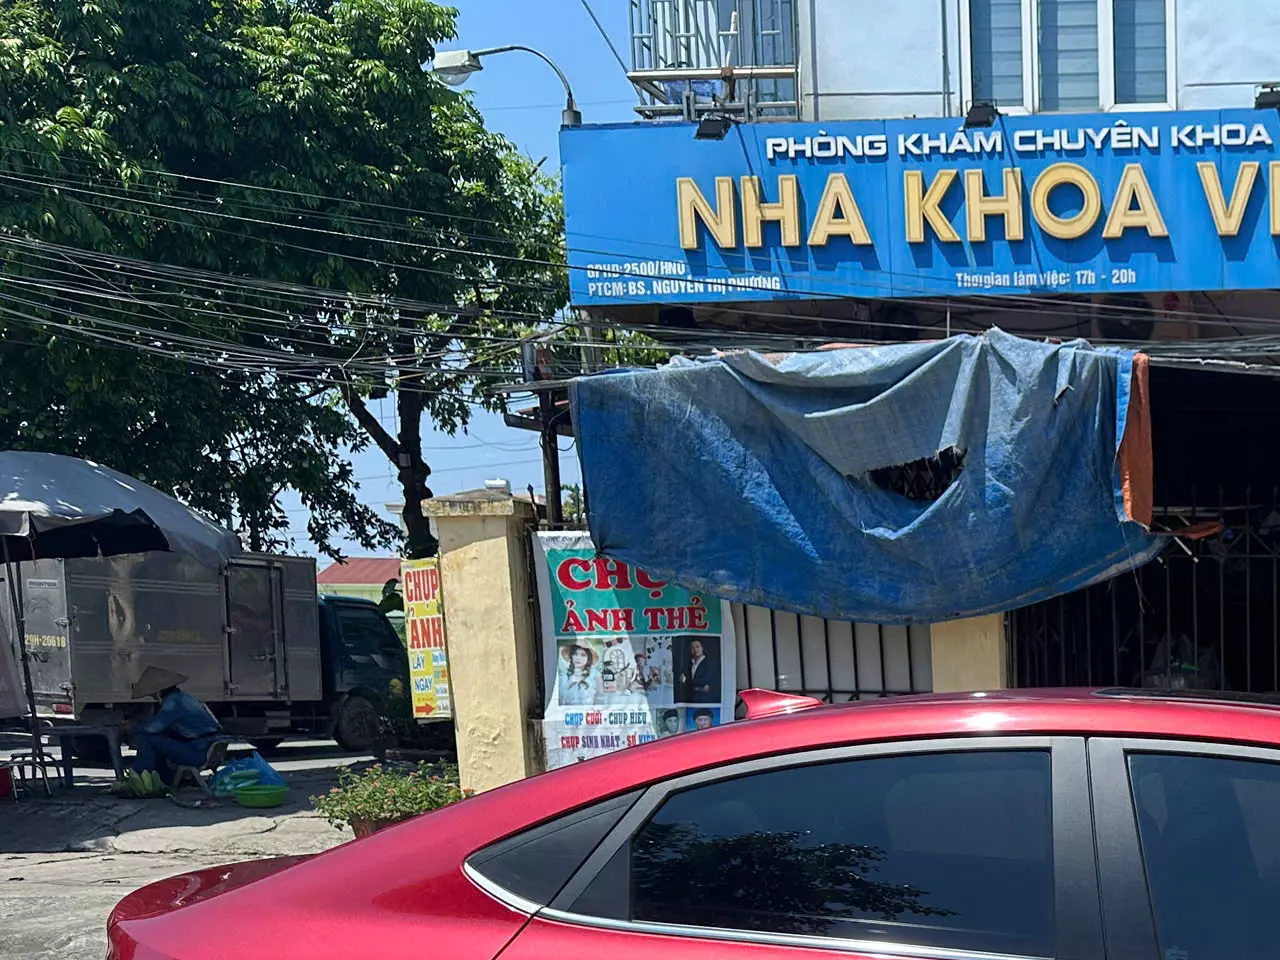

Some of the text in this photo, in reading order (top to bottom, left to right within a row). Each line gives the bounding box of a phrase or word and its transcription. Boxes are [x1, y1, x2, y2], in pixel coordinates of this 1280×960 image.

[766, 130, 887, 159] PHÒNG
[899, 127, 1002, 156] KHÁM
[1013, 119, 1159, 152] CHUYÊN
[1171, 123, 1272, 147] KHOA
[676, 172, 873, 250] NHA
[904, 162, 1168, 244] KHOA
[1075, 270, 1095, 285] 17h
[1112, 268, 1136, 284] 20h
[405, 568, 439, 609] CHỤP
[557, 557, 667, 599] CHỤ
[562, 597, 709, 632] ẢNH THẺ
